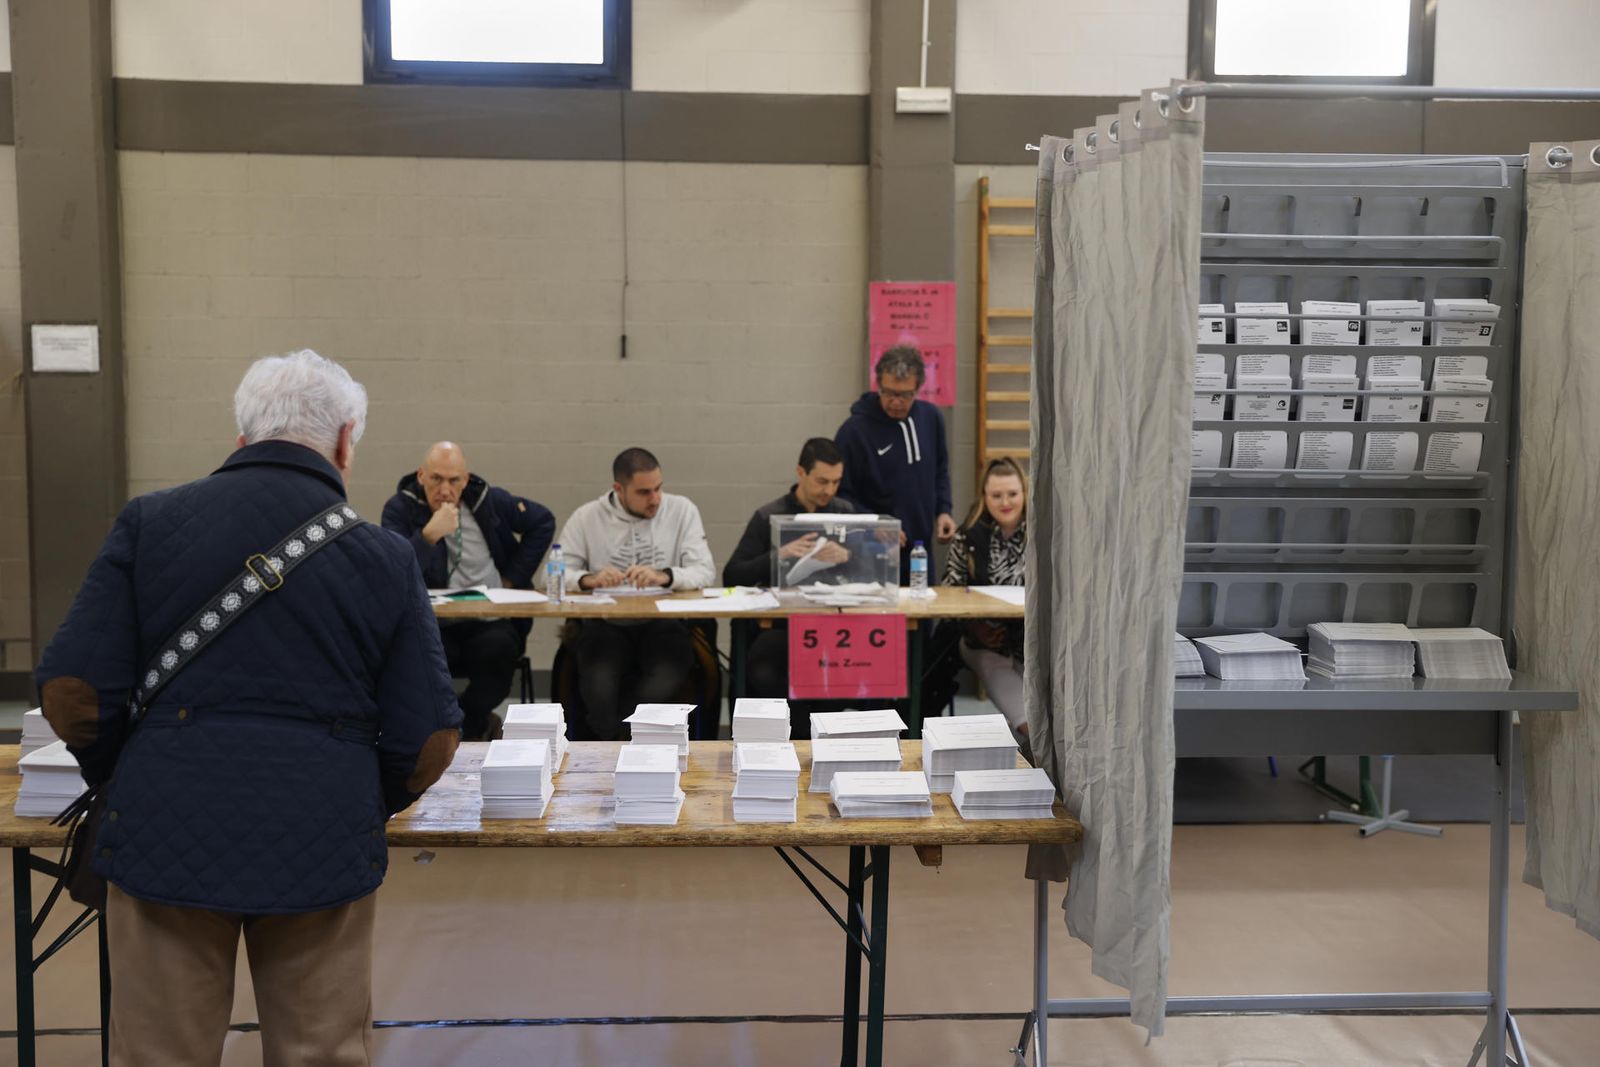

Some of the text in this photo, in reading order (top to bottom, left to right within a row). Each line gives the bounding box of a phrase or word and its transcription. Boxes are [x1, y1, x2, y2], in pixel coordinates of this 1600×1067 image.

[803, 628, 887, 648] 5 2 C
